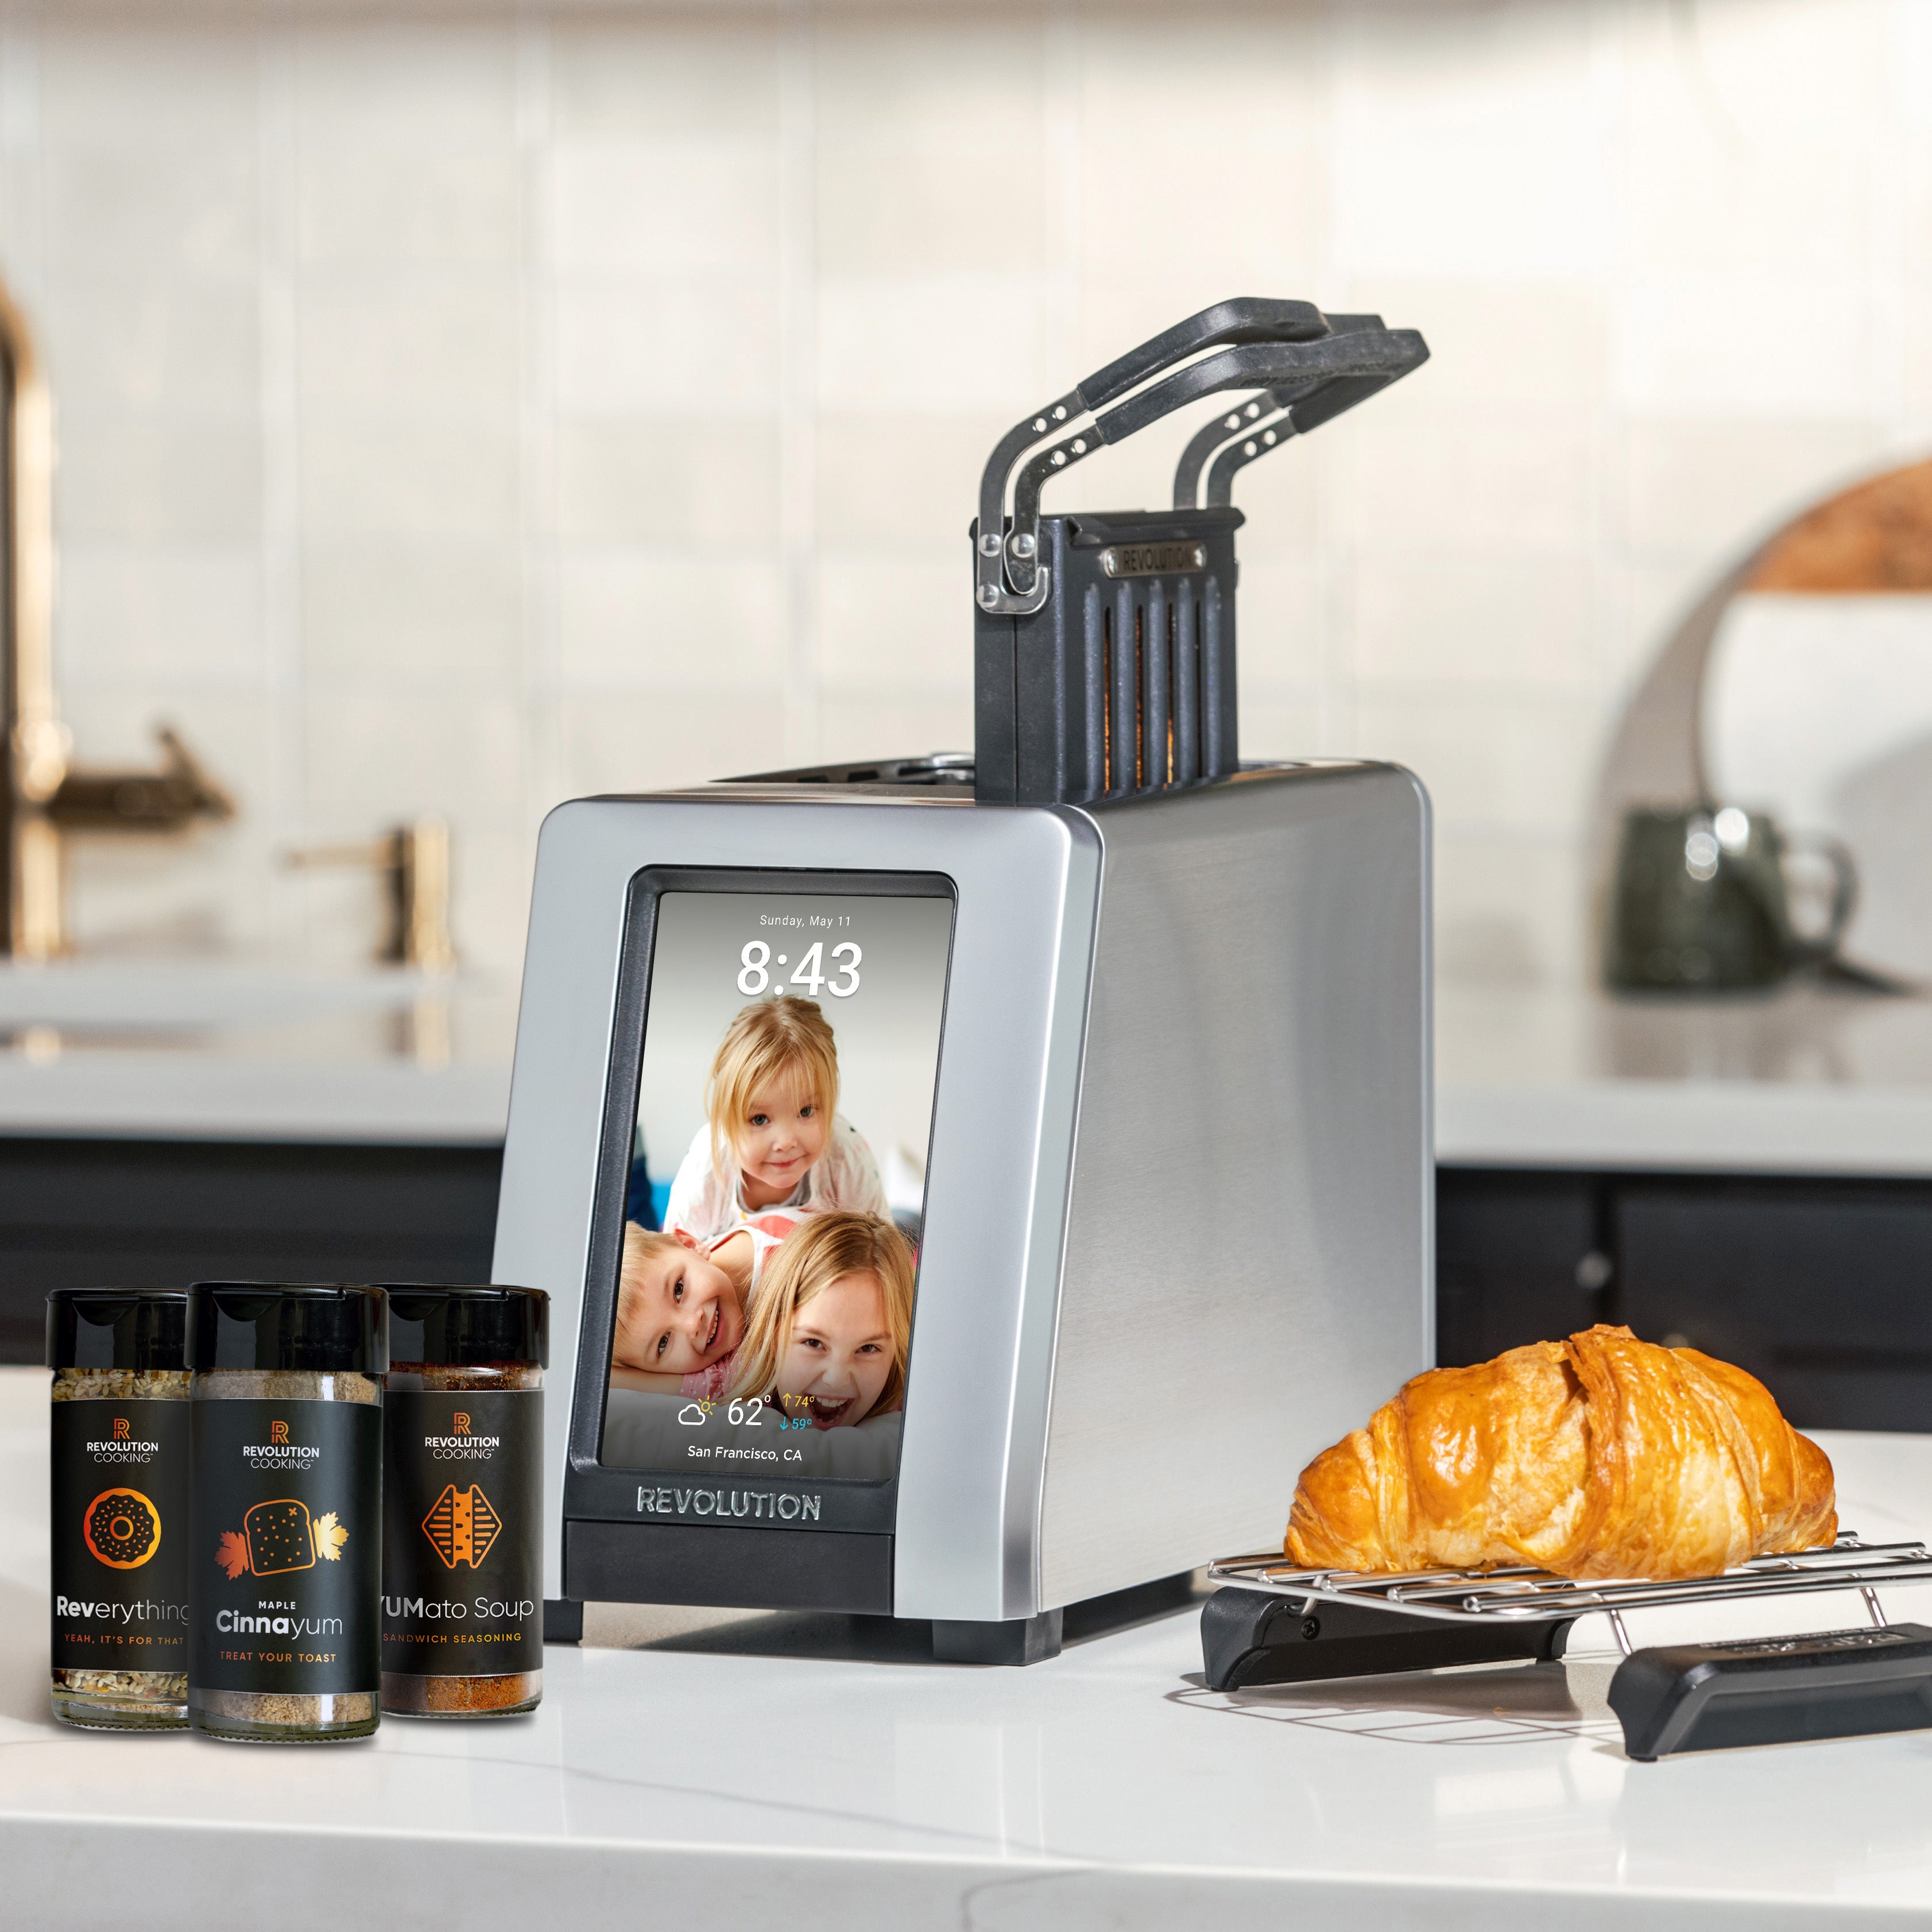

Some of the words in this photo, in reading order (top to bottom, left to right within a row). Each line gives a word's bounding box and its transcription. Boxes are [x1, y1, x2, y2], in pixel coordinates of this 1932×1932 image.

[1123, 547, 1193, 571] REVOLUTON
[760, 915, 804, 928] Sunday,
[810, 916, 833, 928] May
[838, 916, 850, 926] 11
[737, 940, 862, 997] 8:43
[795, 1396, 815, 1407] 74°
[727, 1395, 771, 1426] 62°
[792, 1418, 812, 1430] 59°
[86, 1442, 158, 1451] REVOLUTION
[424, 1437, 500, 1447] REVOLUTION
[243, 1446, 319, 1458] REVOLUTION
[687, 1445, 711, 1457] San
[715, 1446, 779, 1462] Francisco,
[783, 1450, 803, 1461] CA
[637, 1486, 821, 1520] REVOLUTION
[258, 1601, 296, 1609] MAPLE
[474, 1597, 534, 1621] Soup
[216, 1609, 343, 1640] Cinnayum
[64, 1633, 95, 1644] YEAH,
[100, 1635, 123, 1644] IT'S
[129, 1636, 152, 1644] FOR
[383, 1633, 447, 1643] SANDWICH
[453, 1633, 521, 1643] SEASONING
[220, 1651, 253, 1661] TREAT
[259, 1652, 292, 1662] YOUR
[298, 1654, 336, 1663] TOAST
